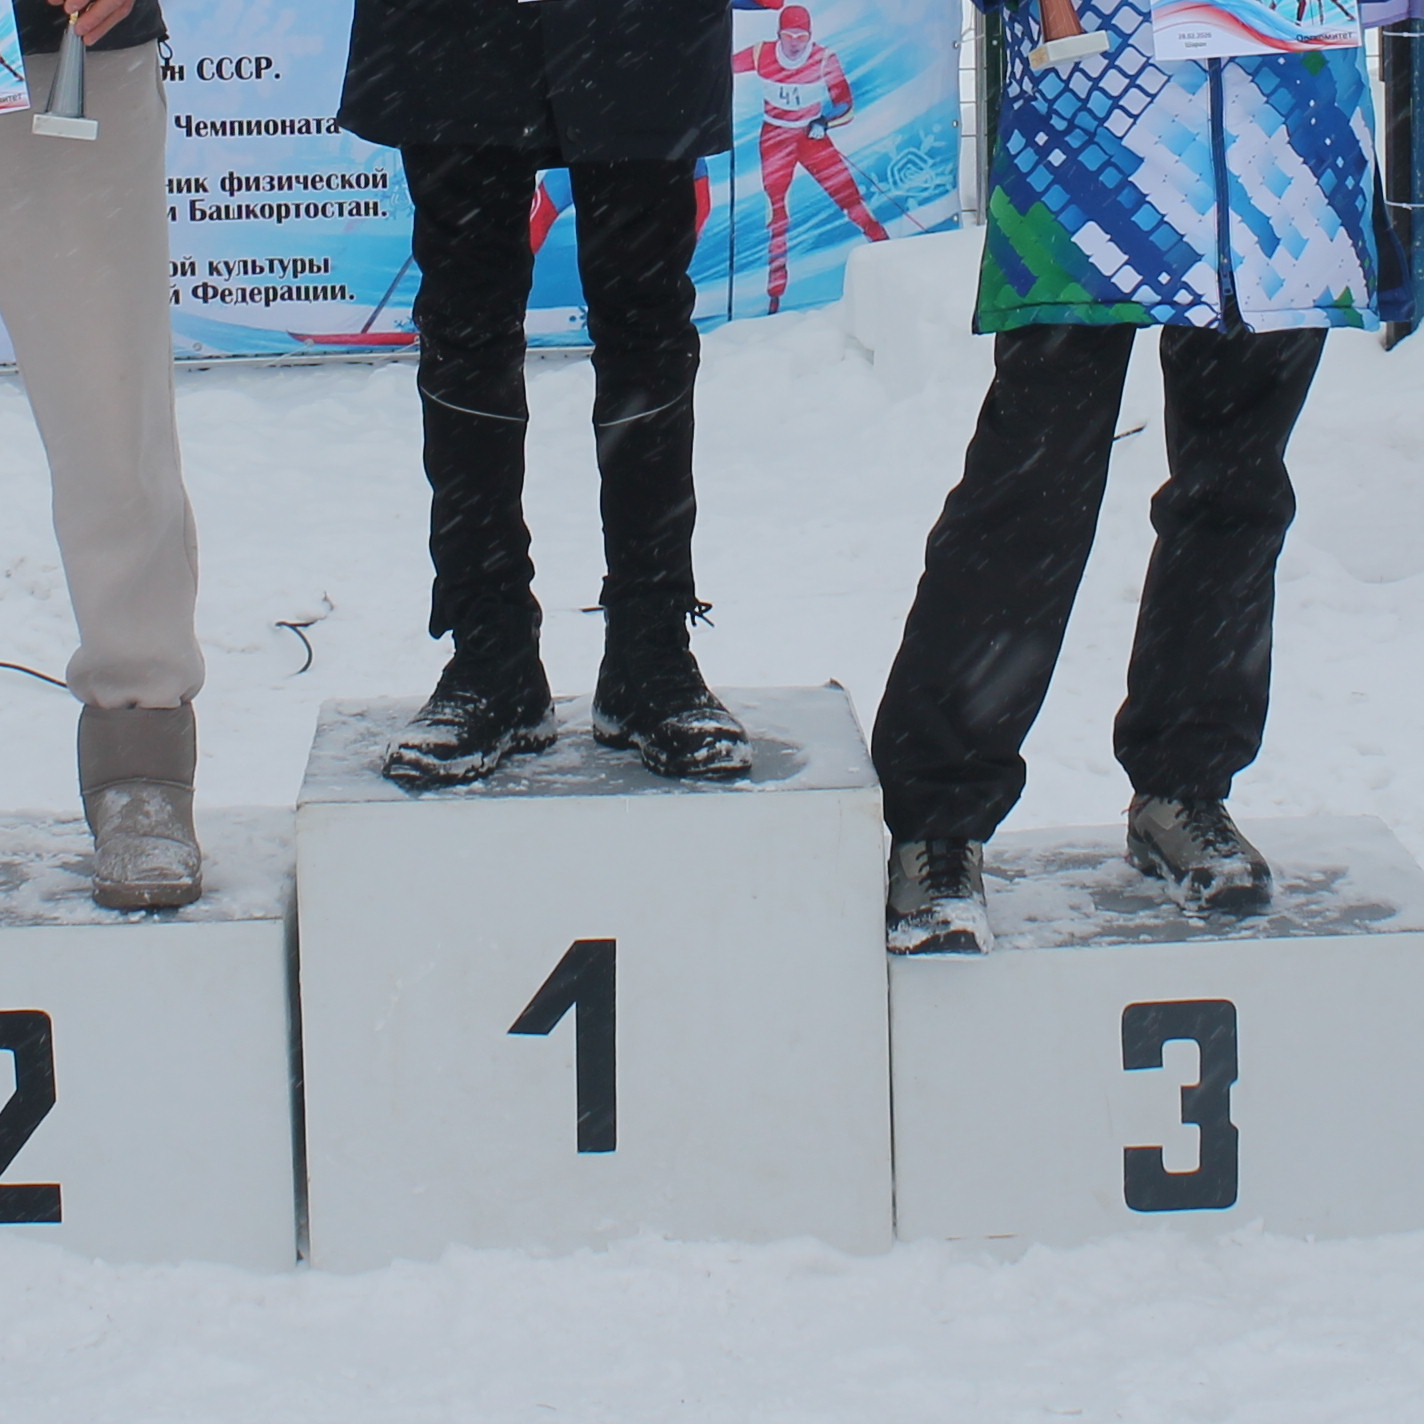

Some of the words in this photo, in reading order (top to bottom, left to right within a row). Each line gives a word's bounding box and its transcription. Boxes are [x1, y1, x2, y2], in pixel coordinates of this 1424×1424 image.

[1295, 30, 1352, 42] Оргкомитет
[196, 56, 281, 81] СССР.
[174, 115, 341, 137] Чемпионата
[220, 168, 388, 196] физической
[189, 199, 388, 224] Башкортостан.
[208, 257, 329, 282] культуры
[191, 282, 355, 307] Федерации.
[507, 938, 617, 1153] 1
[1121, 999, 1239, 1212] 3
